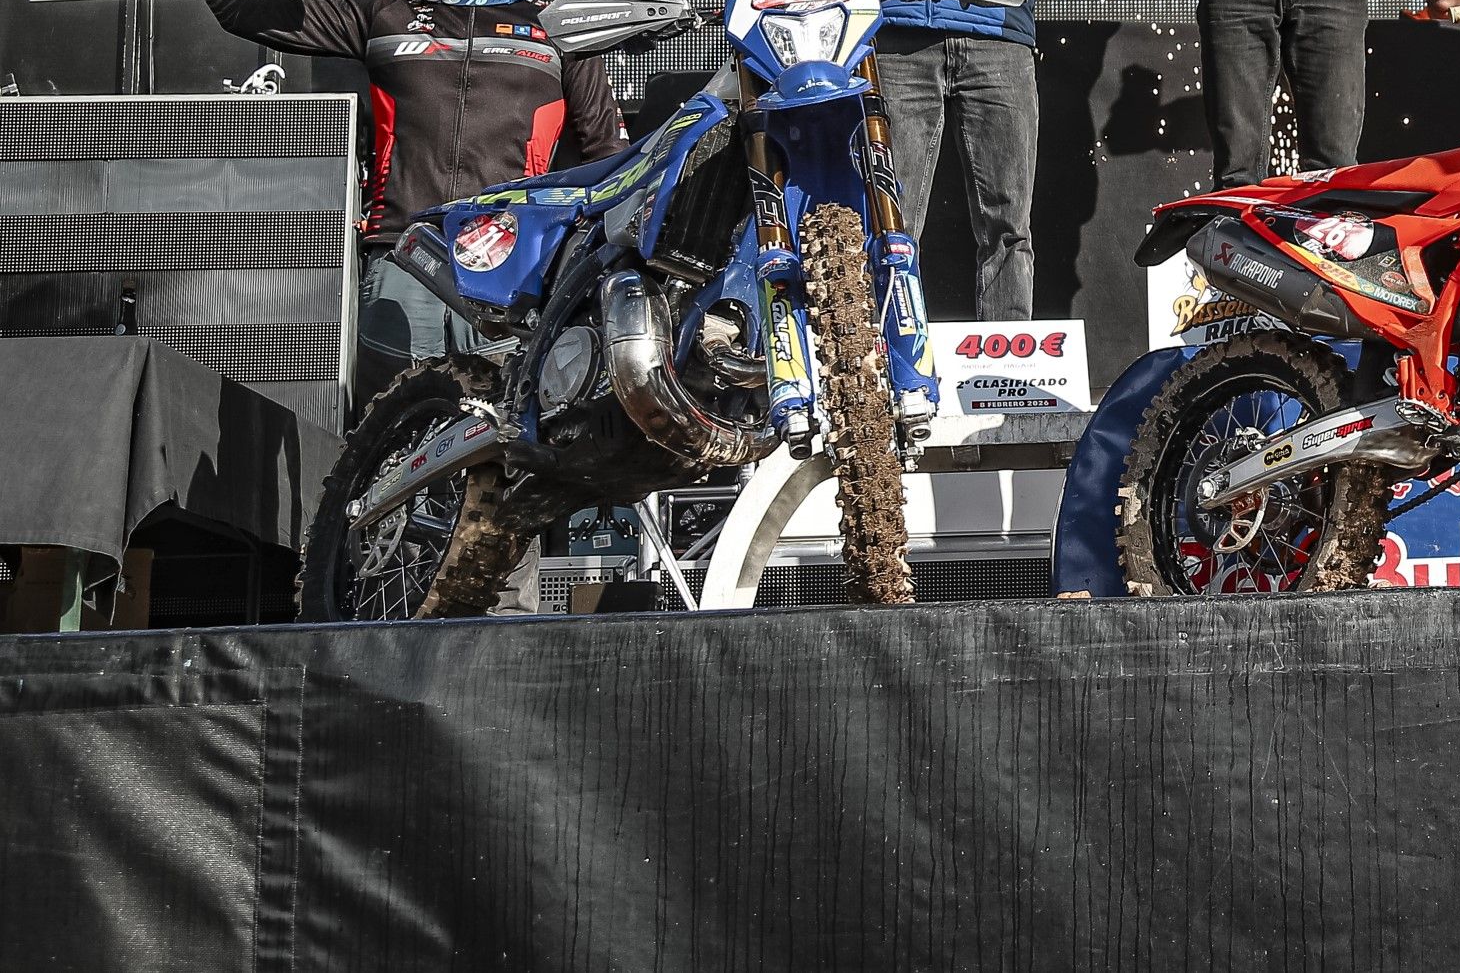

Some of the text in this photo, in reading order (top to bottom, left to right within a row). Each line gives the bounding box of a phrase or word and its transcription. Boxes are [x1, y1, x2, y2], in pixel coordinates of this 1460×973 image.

[560, 10, 632, 26] POLISPORT
[482, 46, 514, 55] ERIC
[1308, 217, 1353, 248] 26
[1373, 287, 1418, 311] MOTOREX
[973, 377, 1068, 389] CLASIFICADO
[997, 388, 1028, 397] PRO
[986, 400, 1025, 409] FEBRERO
